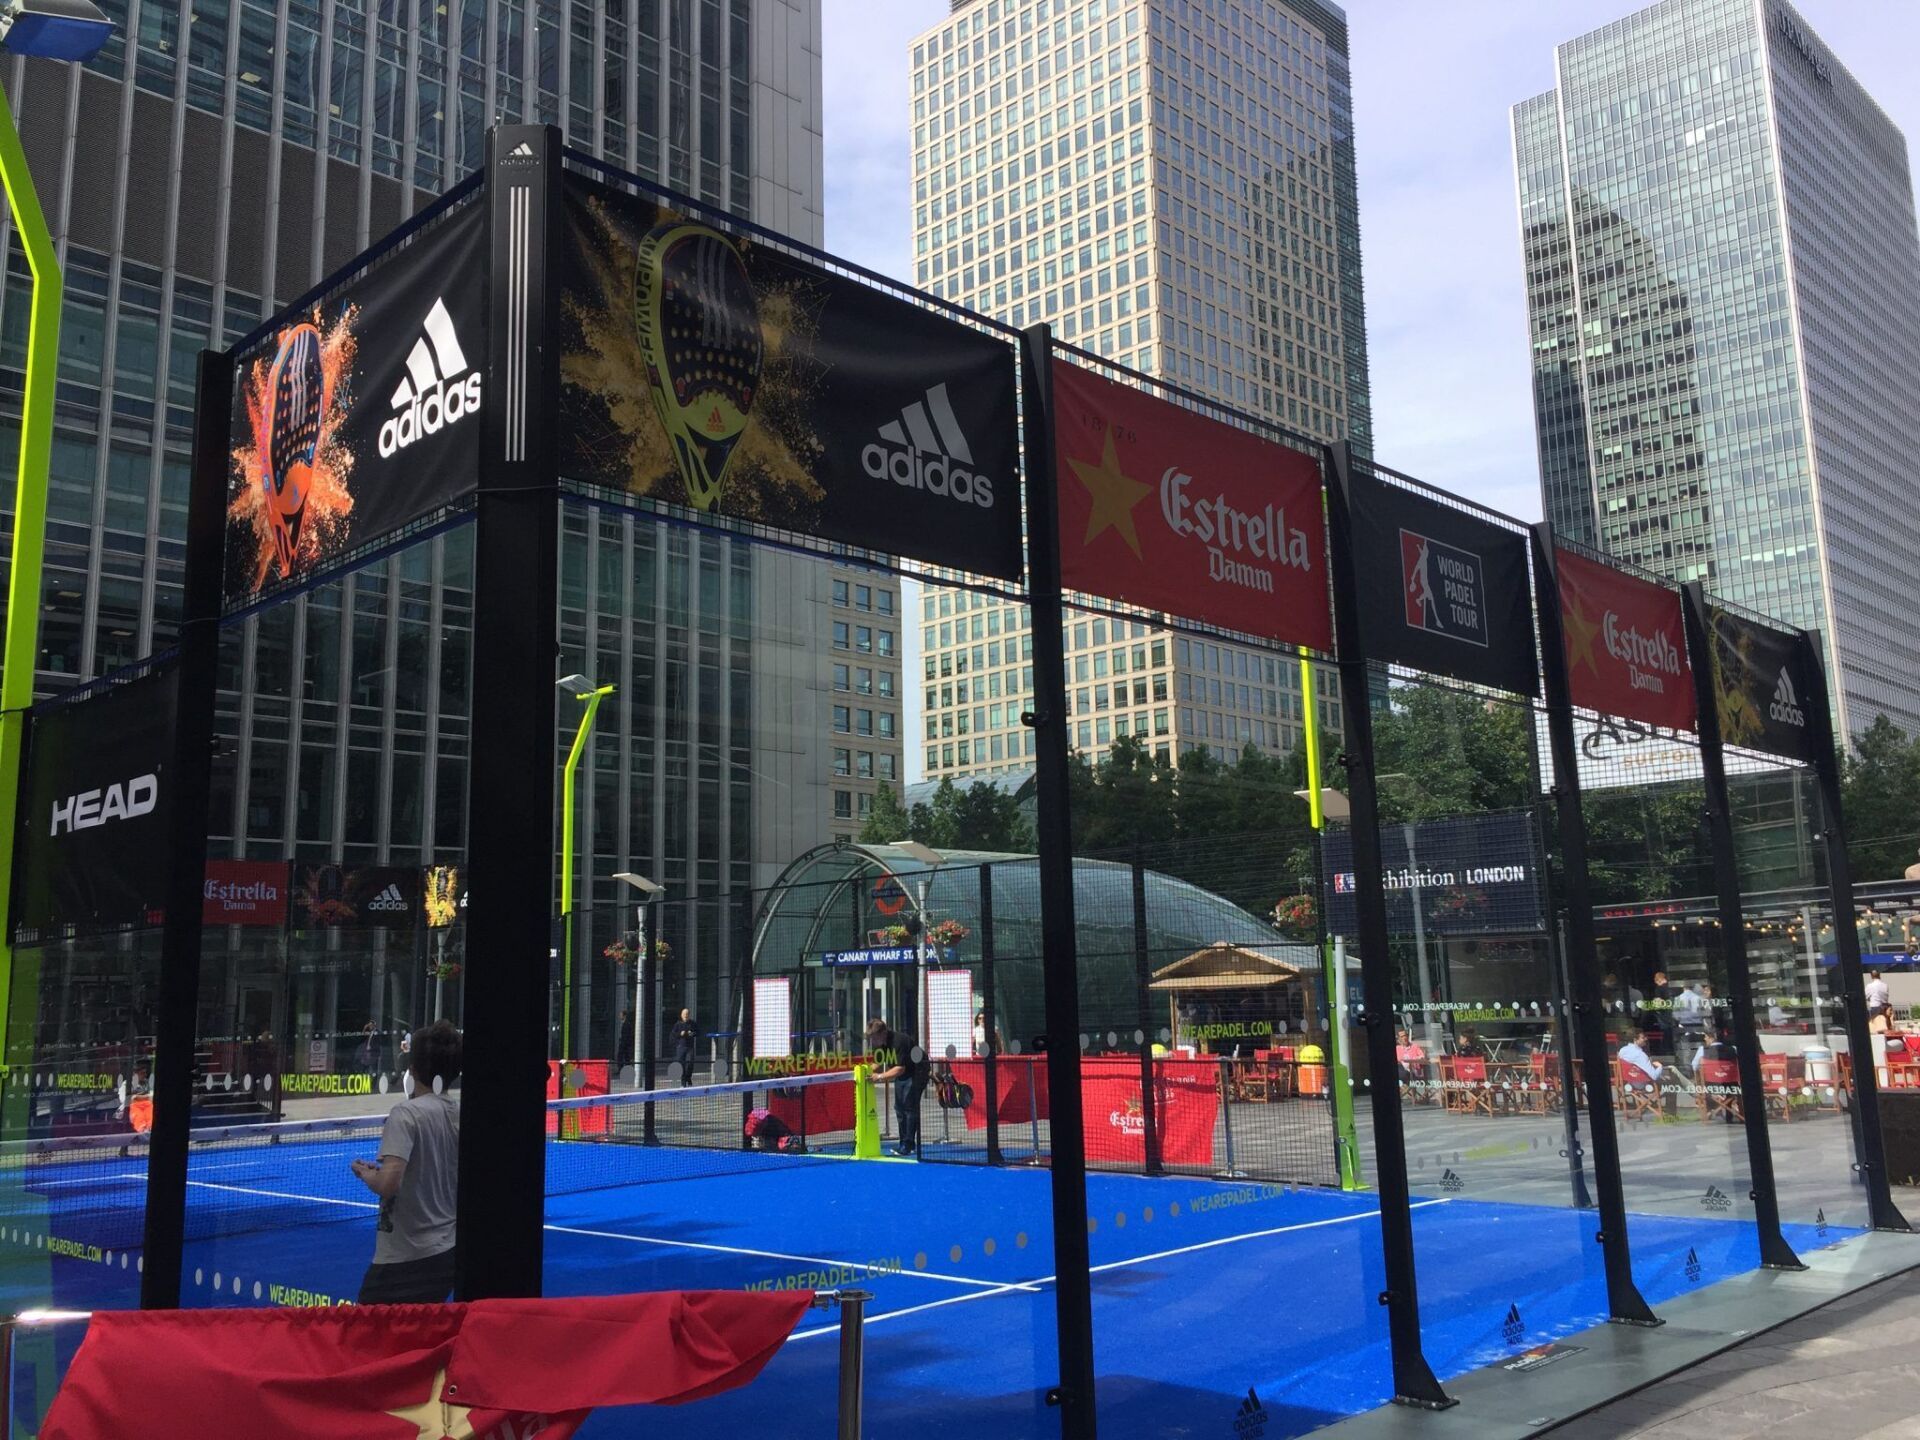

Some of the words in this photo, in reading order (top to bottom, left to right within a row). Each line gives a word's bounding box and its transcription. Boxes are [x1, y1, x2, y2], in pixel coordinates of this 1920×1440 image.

[378, 372, 481, 458] adidas
[861, 443, 994, 508] adidas
[1160, 466, 1311, 572] Estrella
[1207, 545, 1274, 594] Damm
[1437, 554, 1474, 584] WORLD
[1444, 580, 1477, 607] PADEL
[1450, 603, 1478, 630] TOUR
[1602, 609, 1681, 676] Estrella
[1629, 664, 1664, 694] Damm
[1769, 702, 1804, 727] adidas
[50, 773, 158, 837] HEAD
[203, 879, 277, 900] Estrella
[1383, 867, 1454, 889] xhibition
[1466, 865, 1525, 884] LONDON
[368, 899, 408, 911] adidas
[838, 952, 869, 963] CANARY
[872, 950, 900, 961] WHARF
[1453, 1008, 1516, 1023] WEAREPADEL.COM
[1182, 1021, 1273, 1039] WEAREPADEL.COM
[745, 1048, 898, 1076] WEAREPADEL.COM
[57, 1073, 113, 1089] WEAREPADEL.COM
[280, 1073, 372, 1094] WEAREPADEL.COM
[1110, 1110, 1145, 1128] Estre
[1190, 1184, 1284, 1213] WEAREPADEL.COM
[47, 1236, 102, 1263] WEAREPADEL.COM
